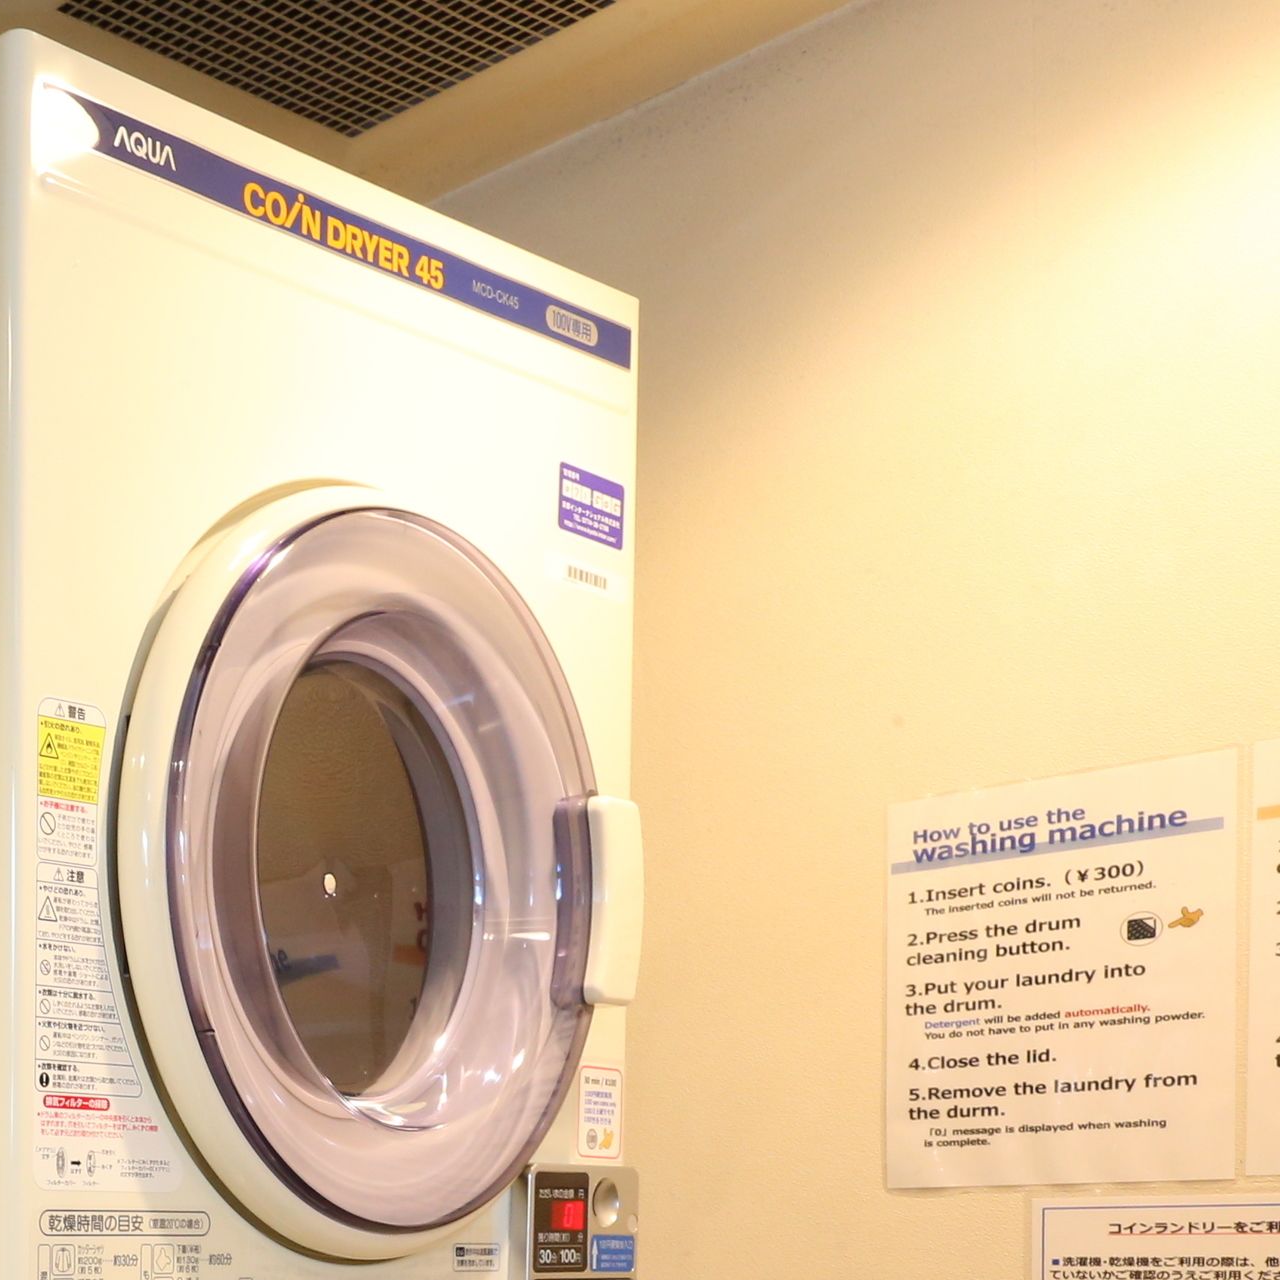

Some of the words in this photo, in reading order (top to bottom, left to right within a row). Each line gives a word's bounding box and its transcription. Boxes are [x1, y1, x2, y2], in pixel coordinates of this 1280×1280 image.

[114, 125, 176, 172] AQUA
[243, 182, 321, 240] COIN
[327, 216, 410, 278] DRYER
[415, 253, 444, 290] 45
[67, 704, 87, 721] 警告
[912, 832, 1036, 864] washing
[1048, 809, 1188, 845] machine
[913, 827, 961, 845] How
[968, 821, 990, 837] to
[999, 815, 1038, 832] use
[1046, 808, 1086, 824] the
[66, 868, 85, 883] 注意
[908, 882, 986, 905] 1.Insert
[993, 876, 1052, 894] coins.
[924, 907, 945, 917] The
[948, 901, 995, 914] inserted
[998, 896, 1028, 908] coins
[1032, 893, 1052, 903] will
[1056, 890, 1076, 901] not
[1079, 888, 1095, 897] be
[1098, 880, 1157, 895] returned.
[907, 928, 979, 947] 2.Press
[985, 923, 1018, 939] the
[1025, 917, 1081, 934] drum
[906, 948, 988, 967] cleaning
[995, 940, 1071, 958] button.
[905, 981, 958, 997] 3.Put
[963, 977, 1009, 995] your
[1015, 969, 1096, 987] laundry
[1104, 964, 1146, 979] into
[905, 1002, 937, 1017] the
[943, 998, 1002, 1014] drum.
[908, 1056, 980, 1071] 4.Close
[986, 1052, 1019, 1066] the
[1026, 1048, 1057, 1063] lid.
[908, 1085, 1007, 1101] 5.Remove
[1013, 1082, 1047, 1096] the
[1054, 1076, 1136, 1094] laundry
[1144, 1073, 1198, 1088] from
[908, 1107, 940, 1121] the
[947, 1105, 1006, 1119] durm.
[48, 1214, 144, 1233] 乾燥時間の目安
